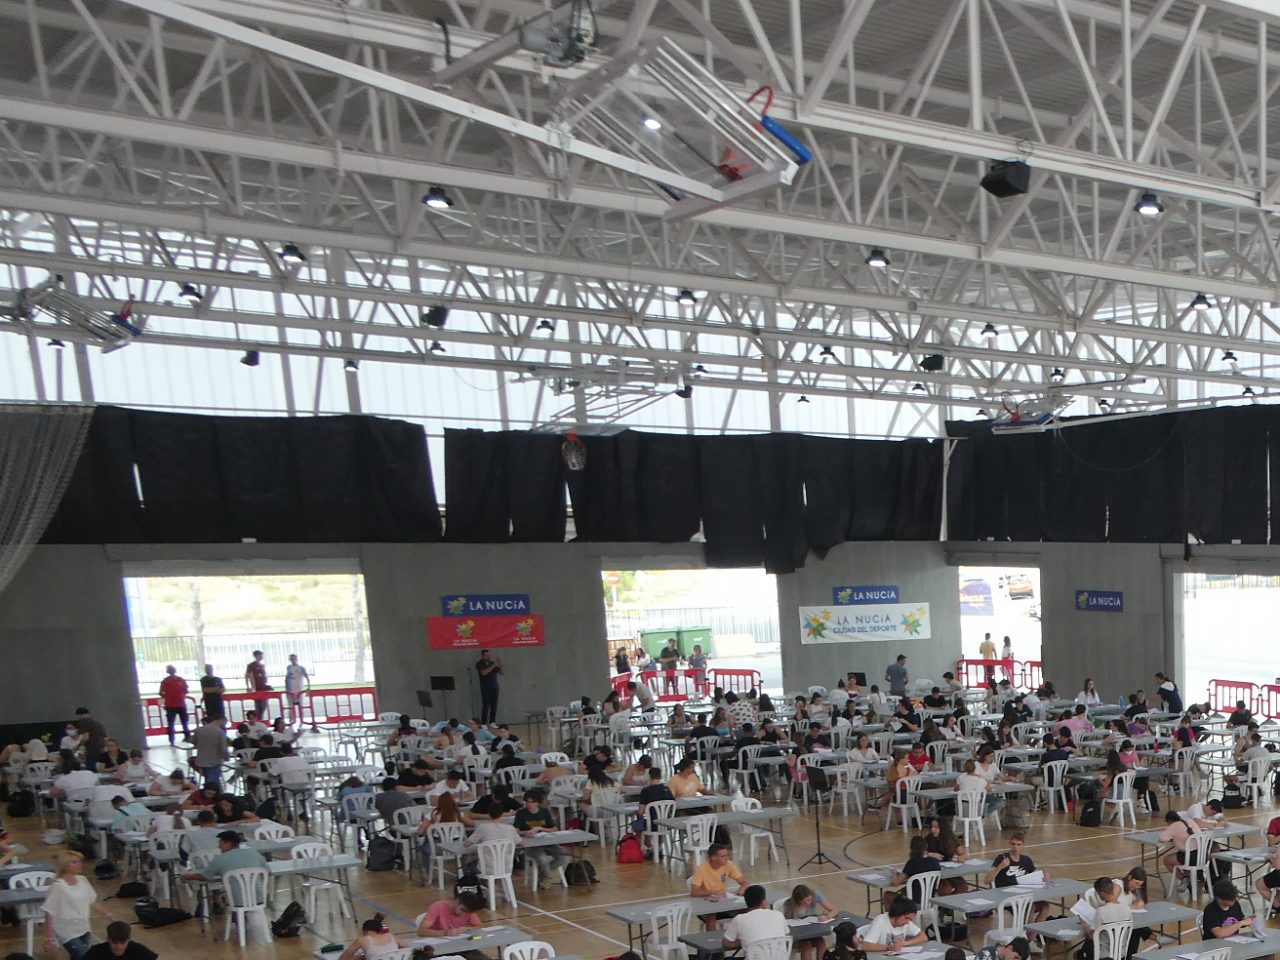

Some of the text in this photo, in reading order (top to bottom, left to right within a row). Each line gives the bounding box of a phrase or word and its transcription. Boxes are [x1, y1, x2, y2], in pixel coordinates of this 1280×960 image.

[853, 591, 865, 600] LA
[470, 601, 484, 611] LA
[837, 616, 849, 625] LA
